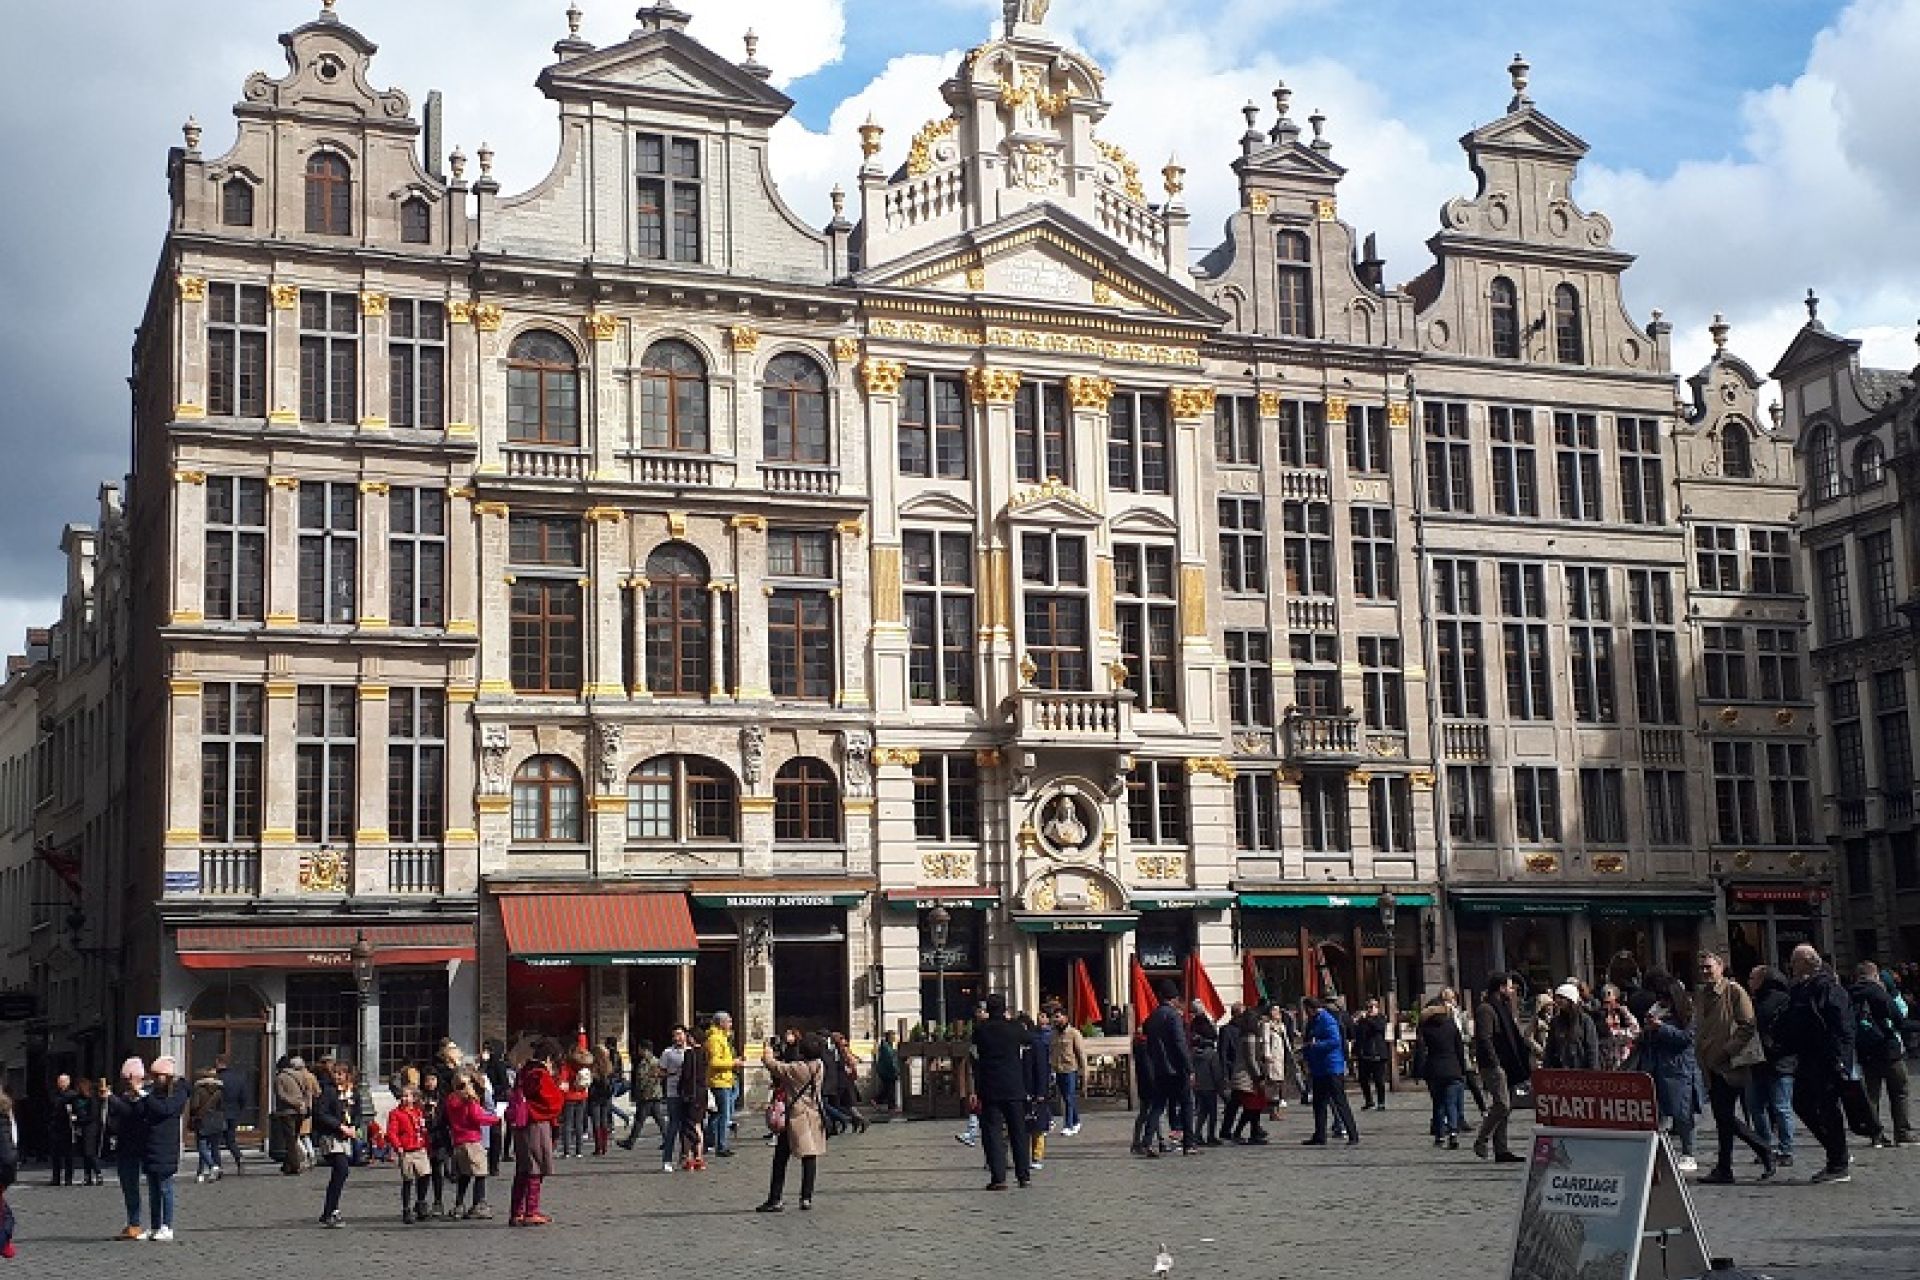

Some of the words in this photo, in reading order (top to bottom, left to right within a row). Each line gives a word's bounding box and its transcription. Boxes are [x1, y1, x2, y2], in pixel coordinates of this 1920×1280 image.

[1537, 1094, 1596, 1120] START
[1600, 1097, 1655, 1122] HERE
[1552, 1175, 1619, 1194] CARRIAGE
[1564, 1192, 1599, 1208] TOUR
